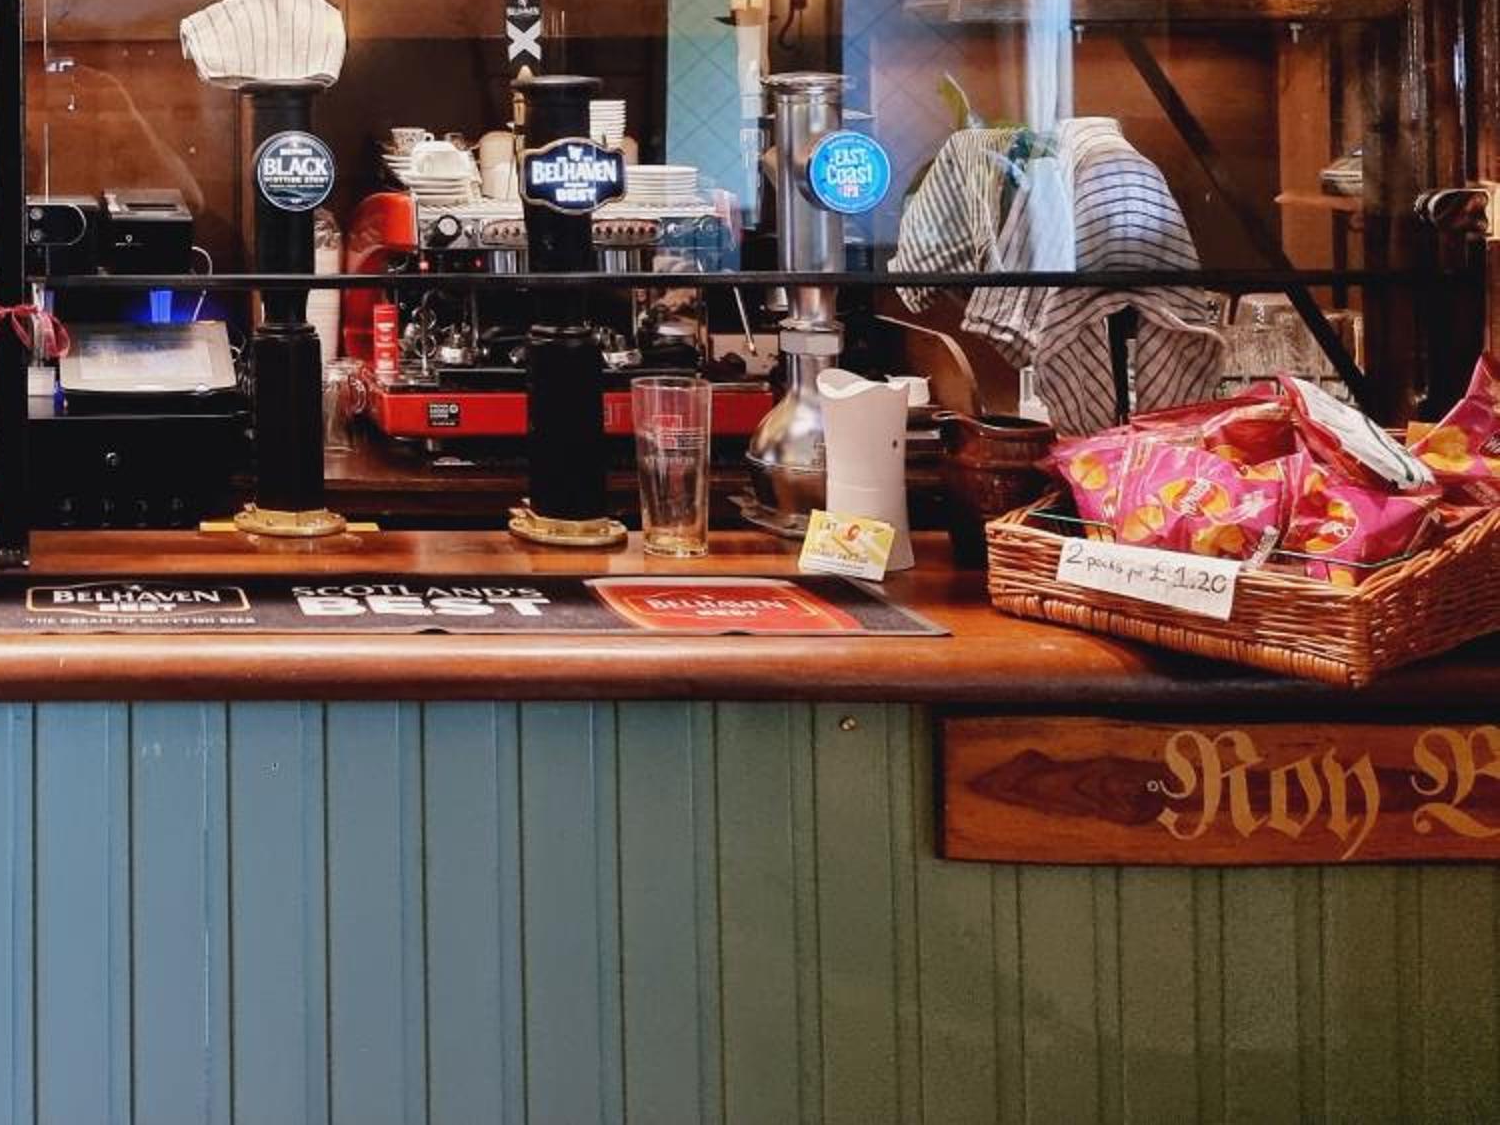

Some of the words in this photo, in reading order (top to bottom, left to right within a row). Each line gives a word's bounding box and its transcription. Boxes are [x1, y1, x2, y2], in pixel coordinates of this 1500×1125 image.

[263, 156, 329, 176] BLACK
[834, 147, 868, 166] EAST
[531, 158, 618, 186] BELHAVEN
[826, 162, 873, 186] Coast
[555, 187, 597, 202] BEST
[1066, 542, 1084, 565] 2
[52, 588, 221, 604] BELHAVEN
[293, 584, 552, 598] SCOTLAND'S
[98, 602, 178, 613] BEST
[297, 595, 552, 616] BEST
[648, 596, 788, 613] BELHAVEN
